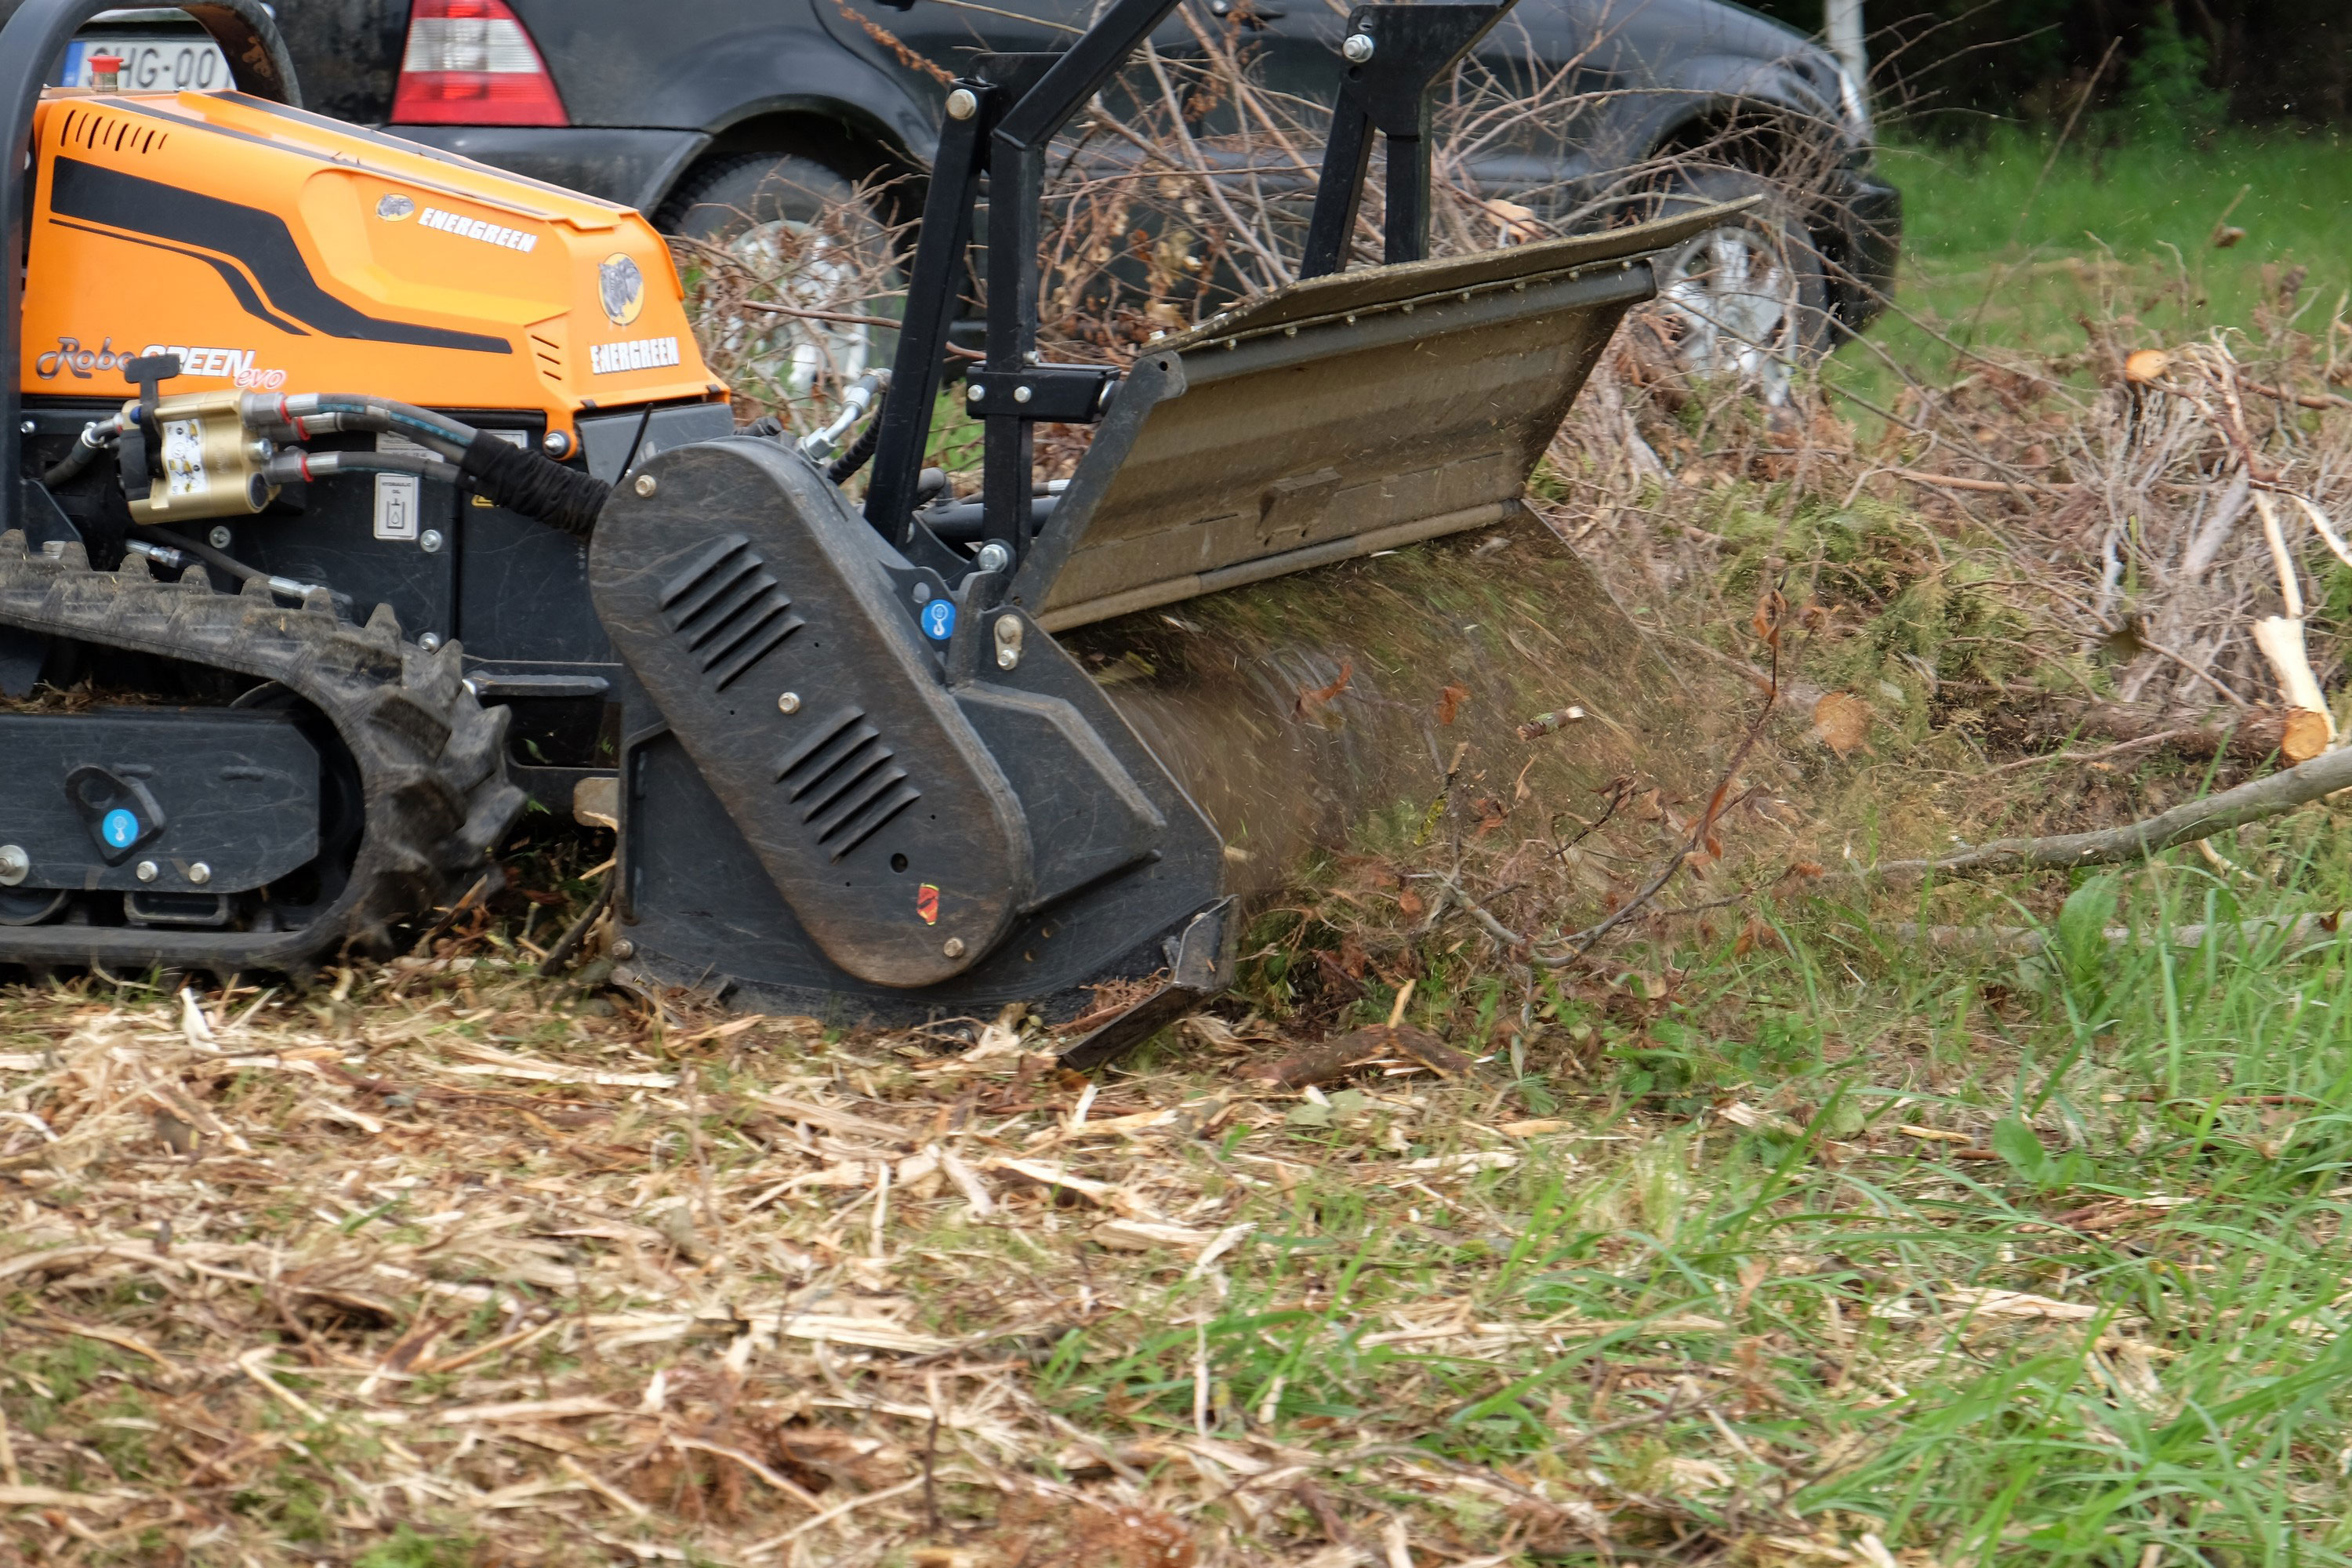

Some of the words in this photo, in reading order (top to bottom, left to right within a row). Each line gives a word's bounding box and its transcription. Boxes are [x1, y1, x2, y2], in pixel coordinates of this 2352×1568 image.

[88, 47, 230, 88] HG-00
[418, 207, 537, 252] ENERGREEN
[590, 337, 680, 375] ENERGREEN
[234, 368, 286, 389] evo
